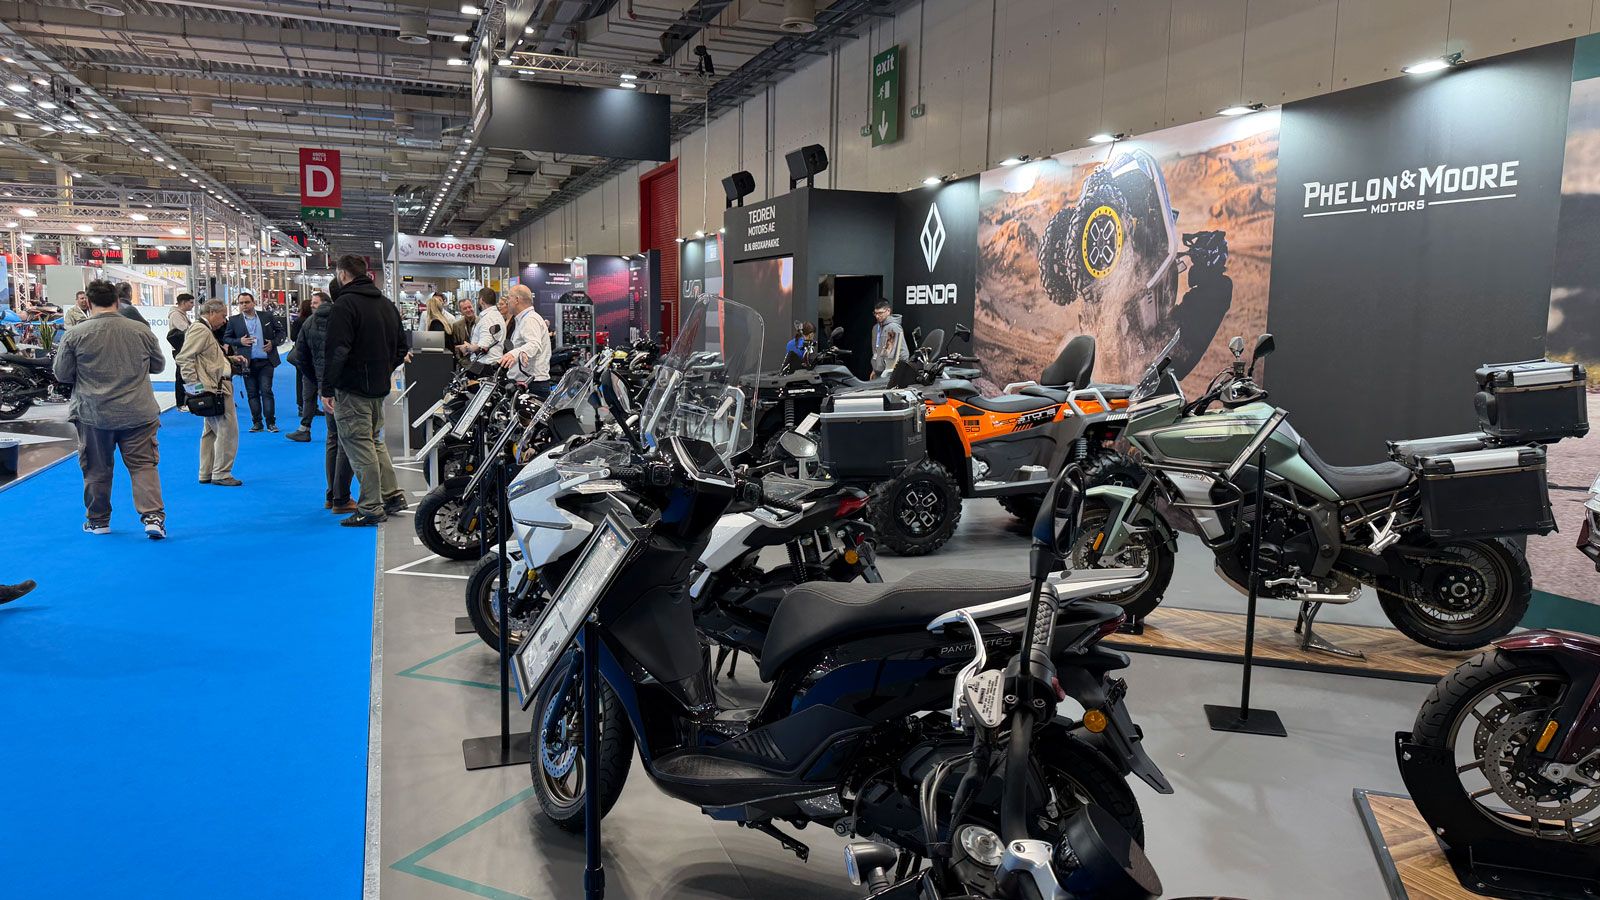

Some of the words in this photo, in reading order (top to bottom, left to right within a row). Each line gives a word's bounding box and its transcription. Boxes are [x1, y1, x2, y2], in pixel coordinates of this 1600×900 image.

[875, 53, 895, 77] exit
[305, 164, 335, 198] D
[748, 205, 776, 225] TEOREN
[1370, 200, 1425, 214] MOTORS
[747, 223, 768, 237] MOTORS
[418, 240, 496, 252] Motopegasus
[419, 250, 455, 258] Motorcycle
[906, 283, 957, 305] BENDA
